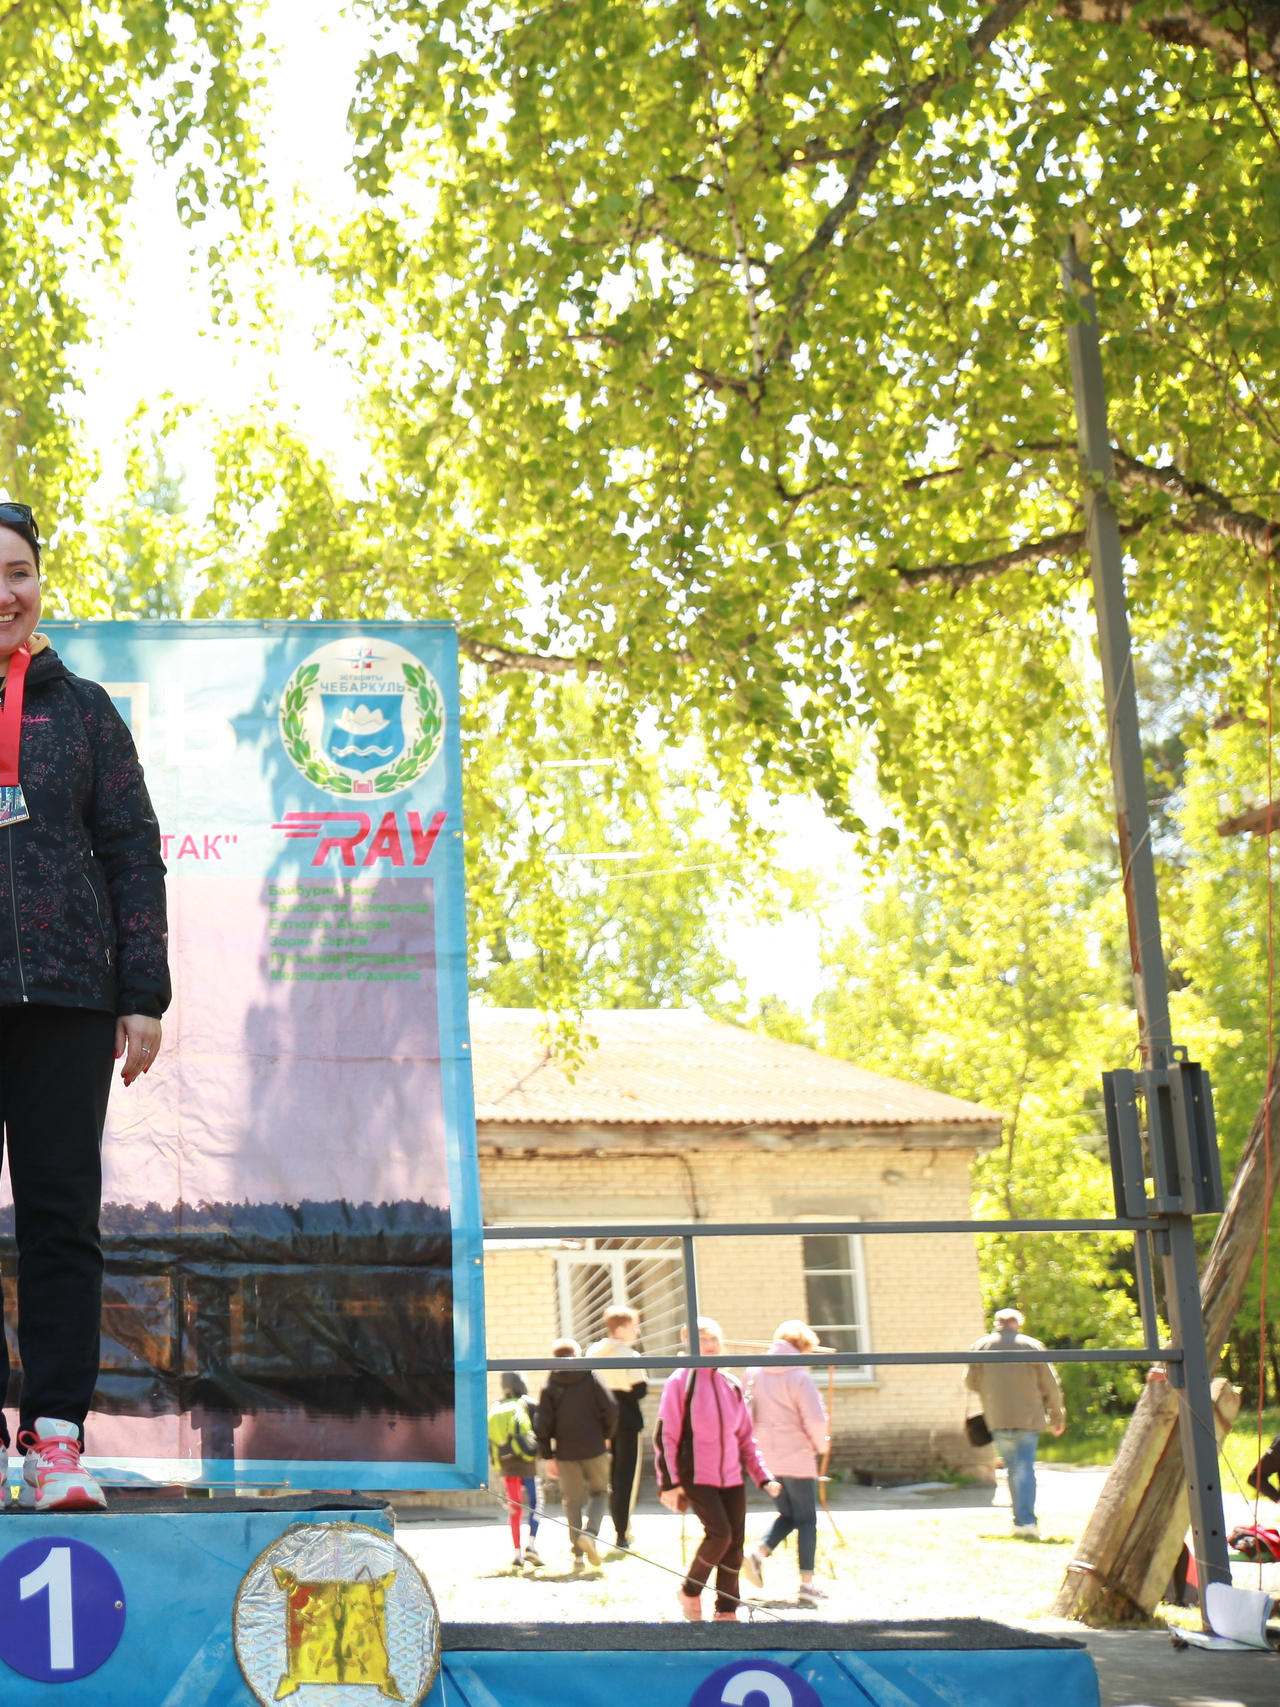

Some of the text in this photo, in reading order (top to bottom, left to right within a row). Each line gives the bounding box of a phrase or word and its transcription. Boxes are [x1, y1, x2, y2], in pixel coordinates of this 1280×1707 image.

[320, 682, 406, 693] ЧЕБАРКУЛЬ
[271, 811, 448, 867] RAY
[20, 1547, 74, 1669] 1
